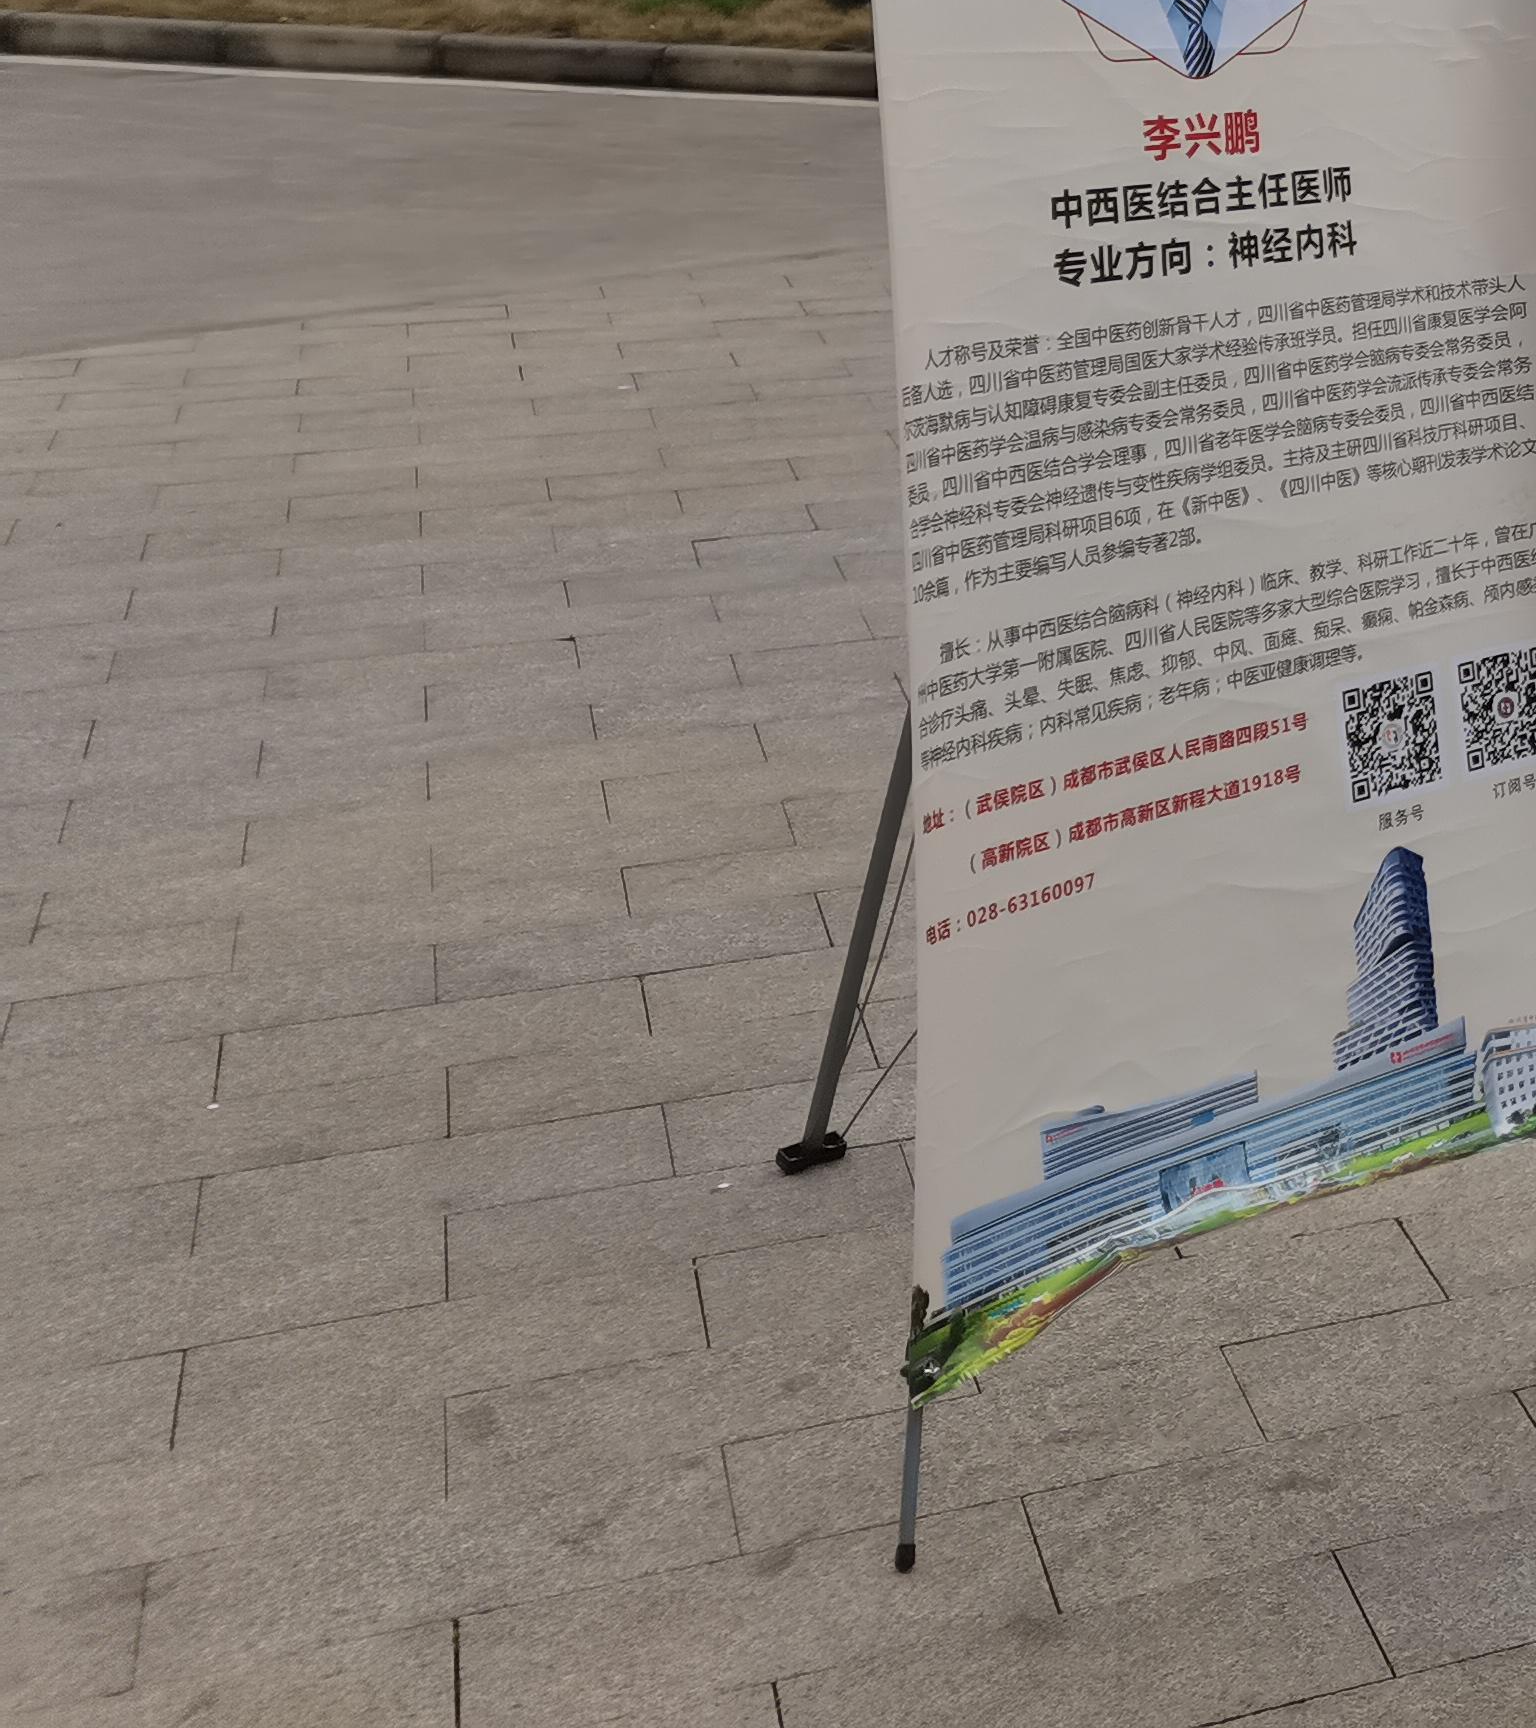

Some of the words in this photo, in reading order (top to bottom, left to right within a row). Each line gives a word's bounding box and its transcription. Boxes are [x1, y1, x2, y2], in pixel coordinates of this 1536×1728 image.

[1143, 109, 1261, 161] 李兴鹏
[1051, 166, 1352, 229] 中西医结合主任医师
[1053, 219, 1357, 287] 专业方向：神经内科
[1492, 773, 1536, 800] 订阅号
[1378, 804, 1424, 831] 服务号
